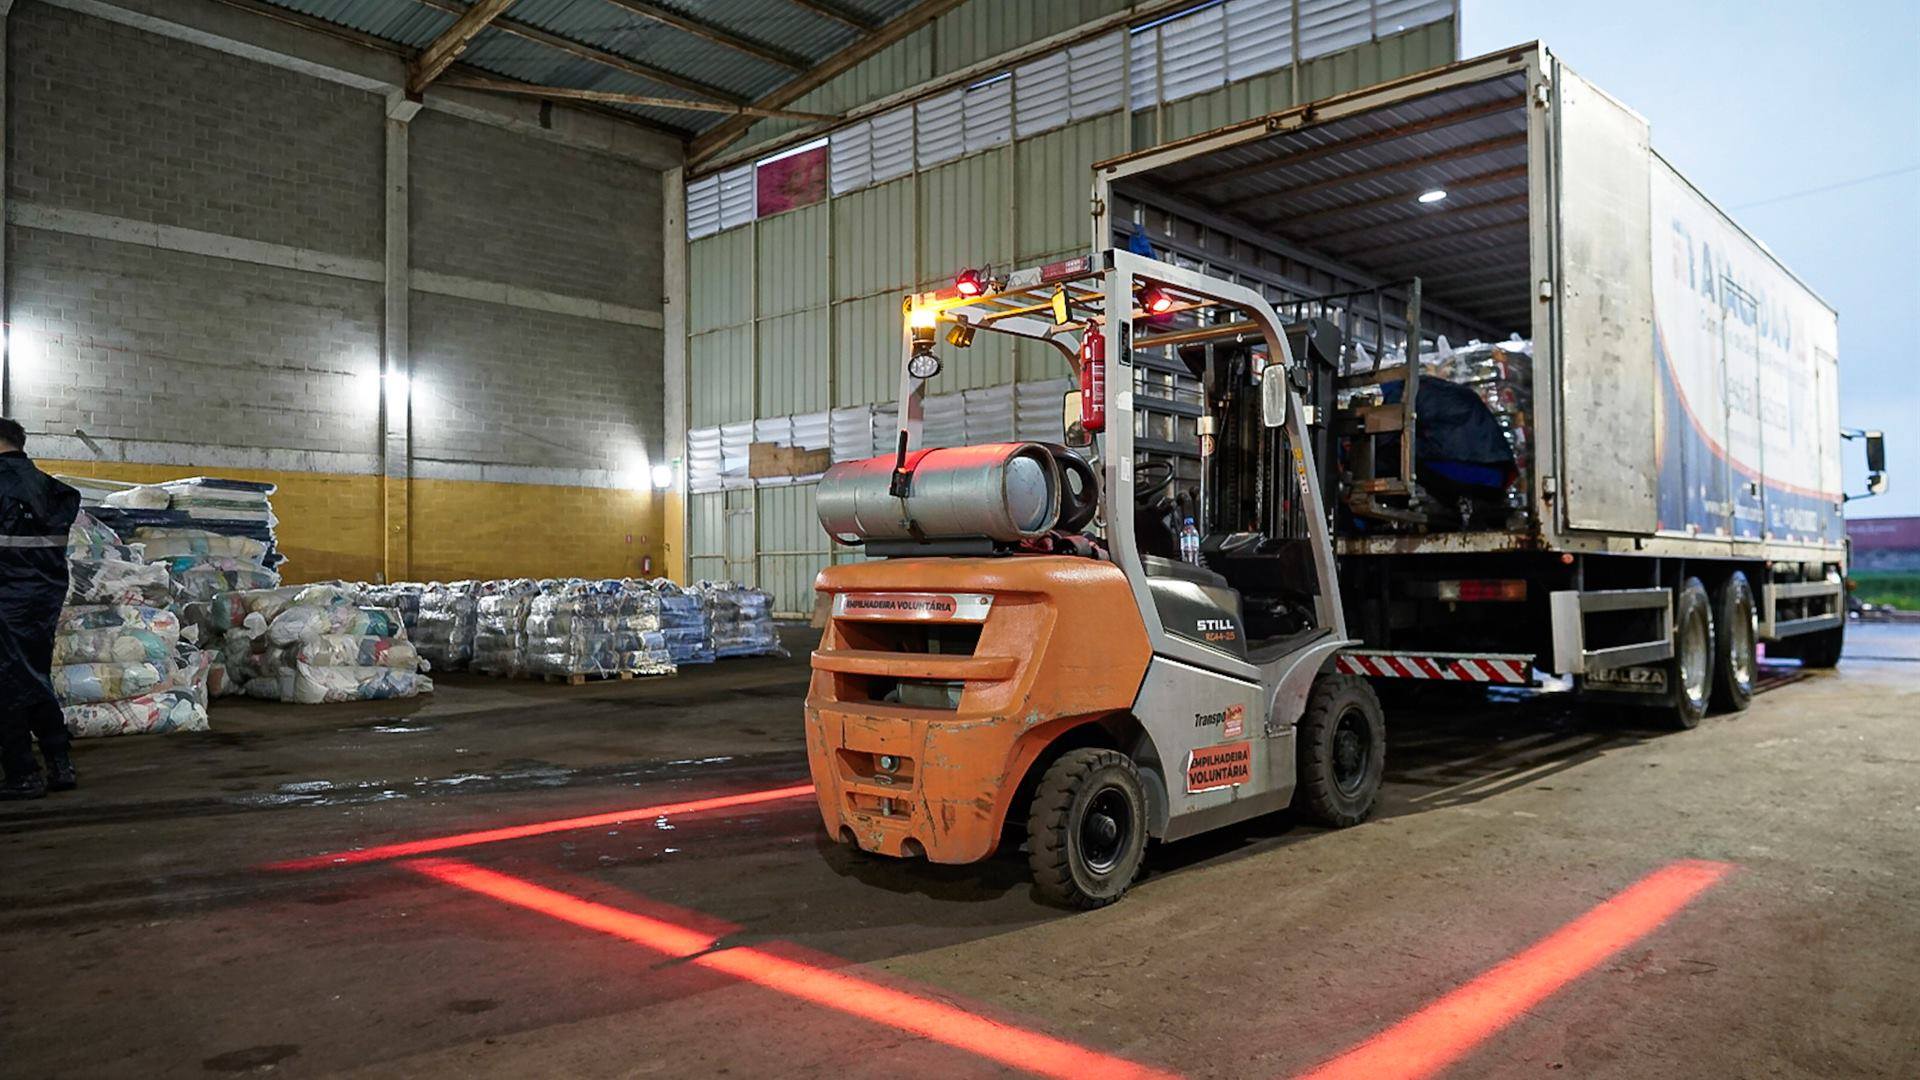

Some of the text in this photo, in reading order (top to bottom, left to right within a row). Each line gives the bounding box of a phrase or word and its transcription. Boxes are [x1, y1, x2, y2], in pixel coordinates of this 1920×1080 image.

[847, 600, 951, 611] EMPILHADEIRA VOLUNTÁRIA
[1197, 619, 1234, 630] STILL
[1588, 669, 1663, 683] REALEZA
[1191, 751, 1248, 768] EMPILHADEIRA
[1189, 763, 1248, 785] VOLUNTÁRIA
